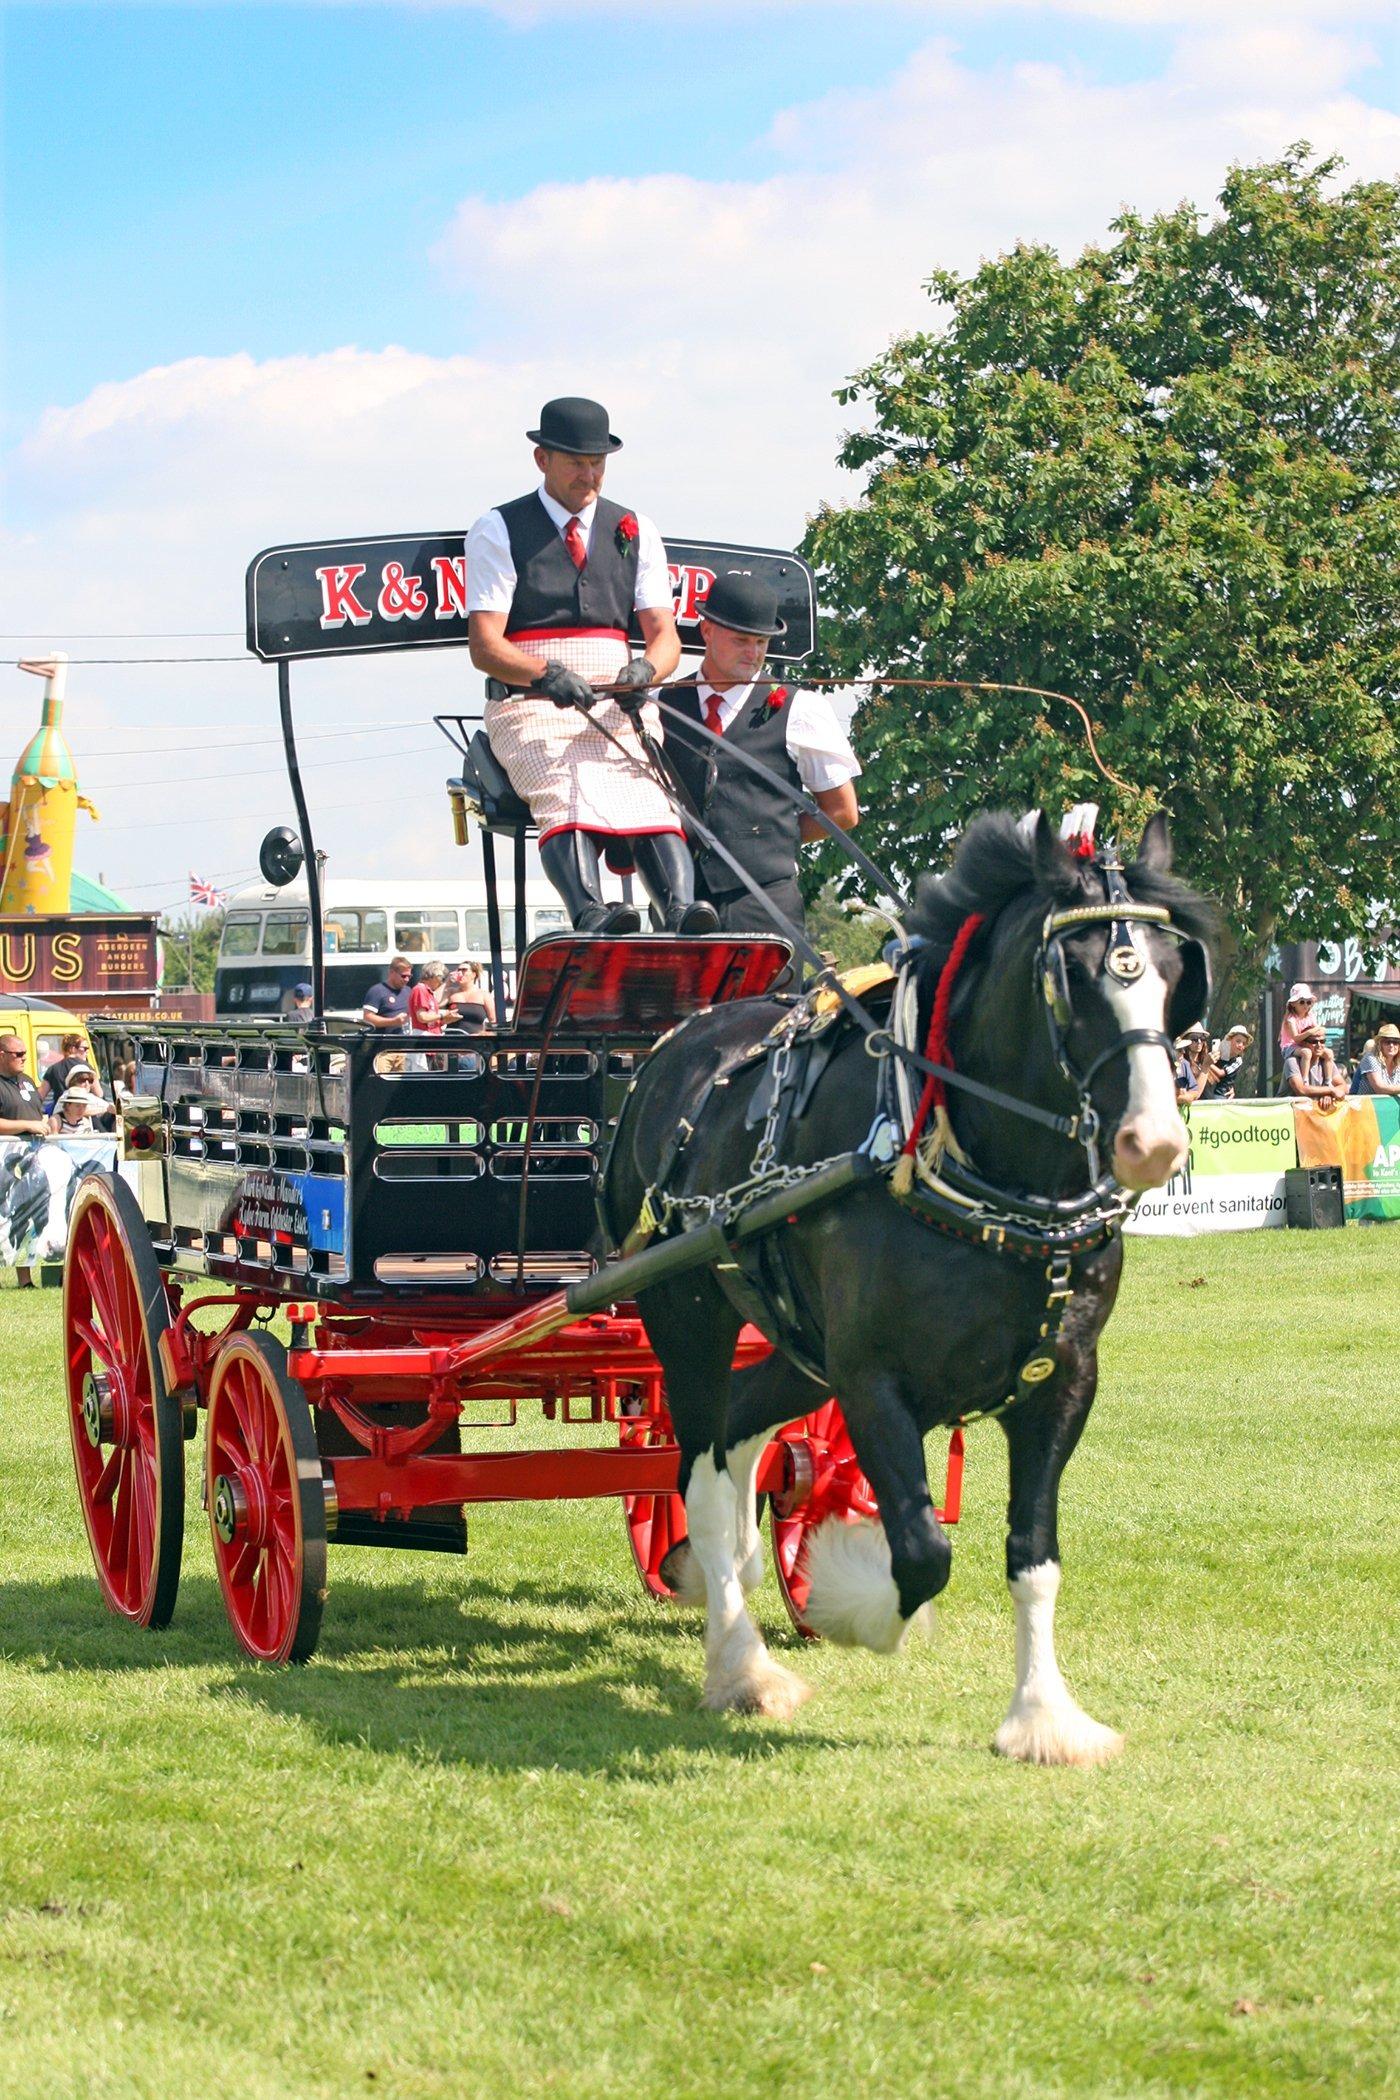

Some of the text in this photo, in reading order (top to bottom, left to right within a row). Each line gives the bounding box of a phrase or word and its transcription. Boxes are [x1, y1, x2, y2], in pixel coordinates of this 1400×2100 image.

[315, 563, 373, 630] K
[377, 561, 429, 622] &
[97, 943, 148, 951] ABERDEEN
[107, 953, 139, 961] ANGUS
[101, 963, 145, 971] BURGERS
[1199, 1125, 1290, 1149] #goodtogo
[1132, 1203, 1169, 1222] your
[1173, 1199, 1214, 1215] event
